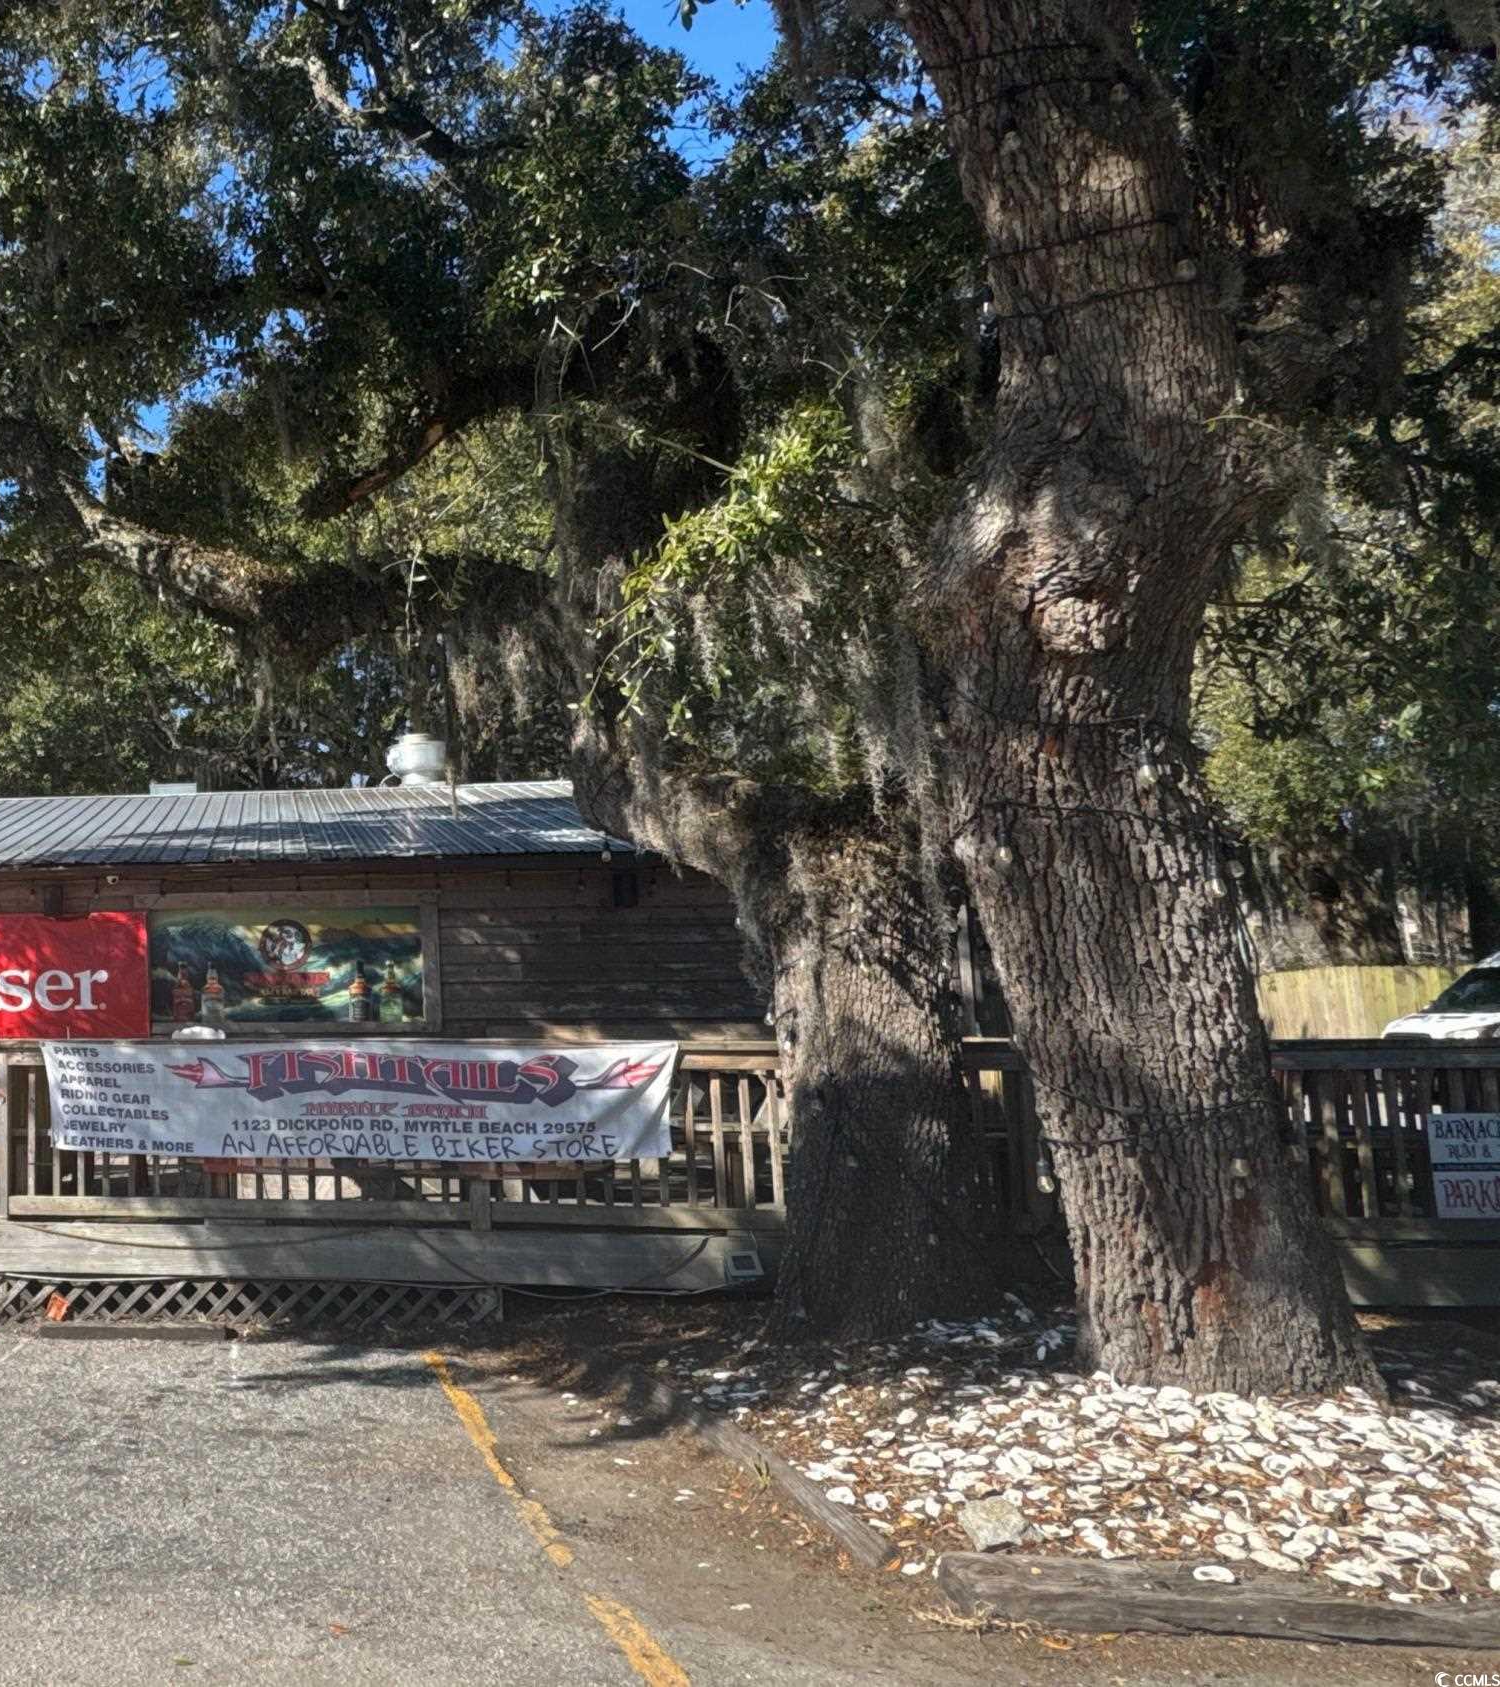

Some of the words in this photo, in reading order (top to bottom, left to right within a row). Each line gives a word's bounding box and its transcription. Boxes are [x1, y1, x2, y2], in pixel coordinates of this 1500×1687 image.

[53, 1046, 100, 1057] PARTS
[57, 1060, 156, 1074] ACCESSORIES
[60, 1074, 122, 1089] APPAREL
[238, 1049, 572, 1103] FISHTAILS
[60, 1088, 108, 1102] RIDING
[112, 1093, 151, 1105] GEAR
[62, 1103, 170, 1121] COLLECTABLES
[63, 1119, 126, 1133] JEWELRY
[231, 1119, 271, 1131] 1123
[277, 1119, 365, 1131] DICKPOND
[370, 1120, 398, 1134] RD,
[404, 1121, 473, 1134] MYRTLE
[479, 1122, 538, 1135] BEACH
[543, 1121, 597, 1135] 29575
[64, 1135, 134, 1149] LEATHERS
[138, 1140, 148, 1150] &
[152, 1141, 195, 1153] MORE
[221, 1133, 255, 1156] AN
[266, 1133, 420, 1157] AFFORDABLE
[432, 1136, 521, 1159] BIKER
[533, 1135, 619, 1158] STORE
